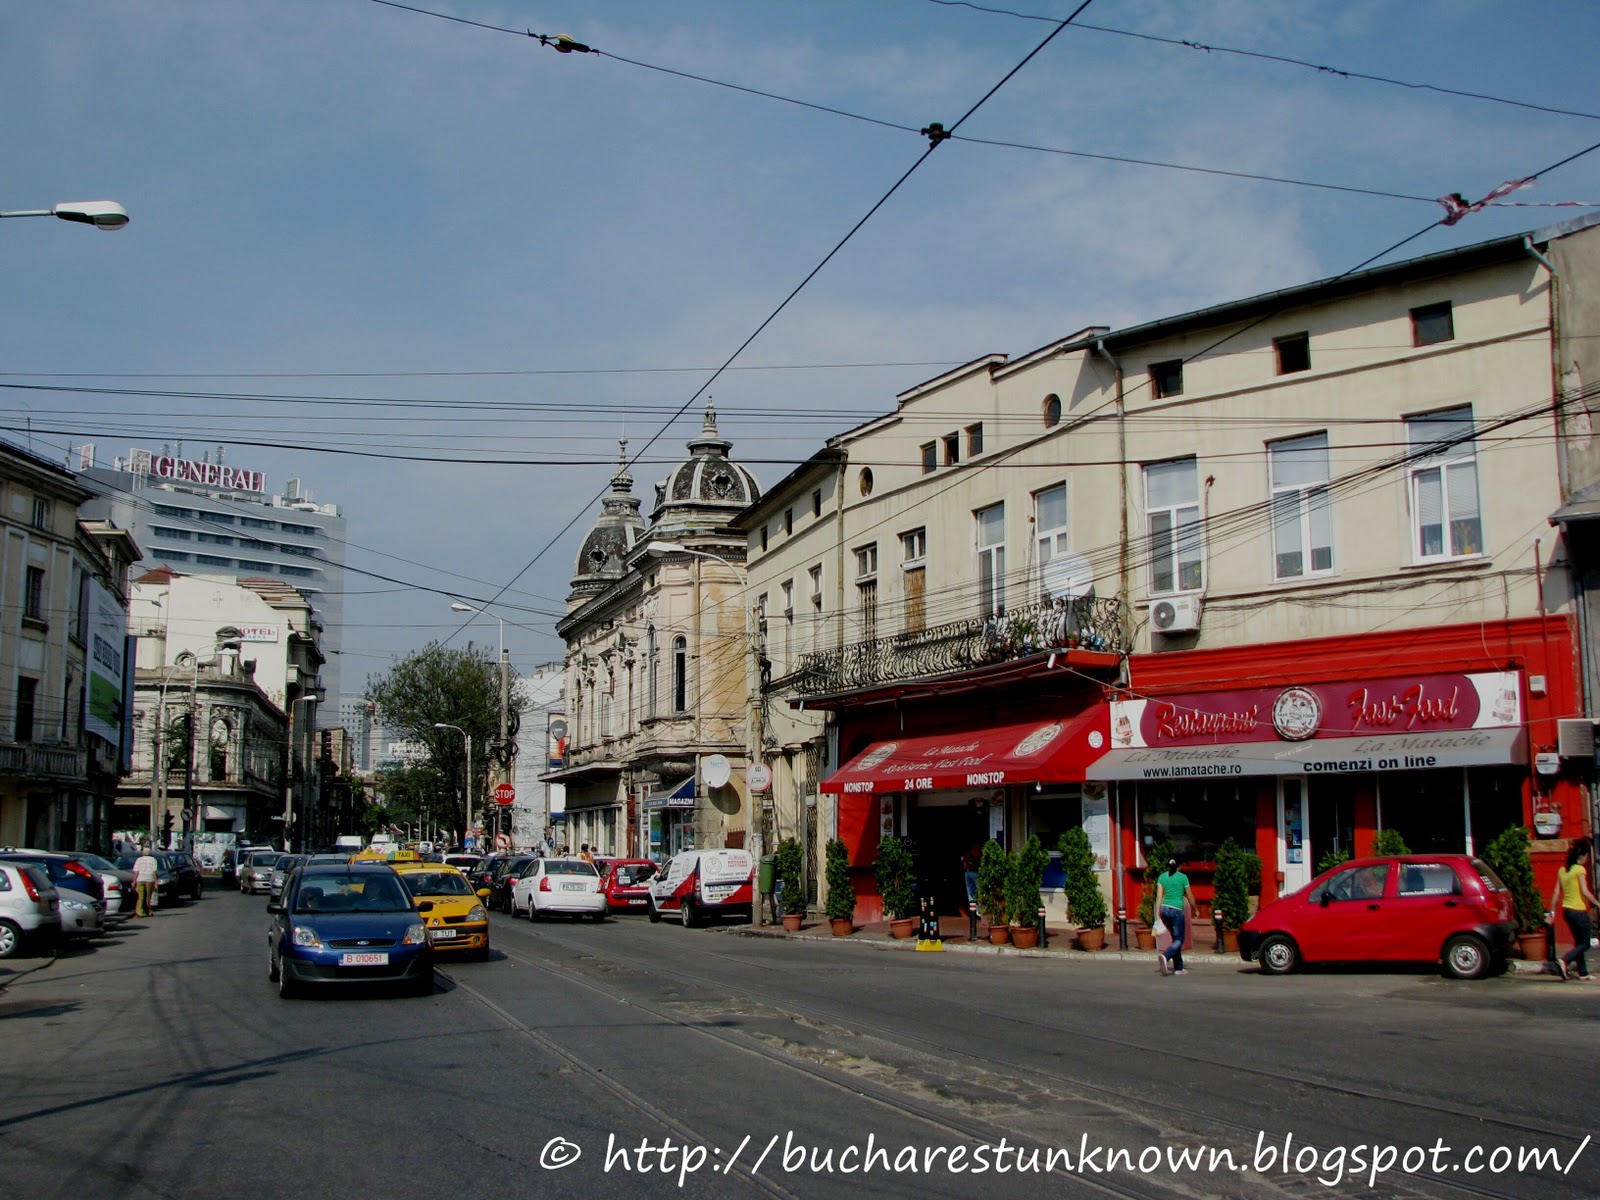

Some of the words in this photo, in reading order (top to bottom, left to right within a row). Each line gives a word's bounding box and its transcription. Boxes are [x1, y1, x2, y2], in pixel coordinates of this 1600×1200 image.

[156, 456, 268, 493] GENERALI
[1155, 702, 1258, 740] Restaurant
[1353, 740, 1385, 753] La
[1389, 732, 1492, 751] Matache
[922, 747, 937, 757] La
[1122, 751, 1149, 763] La
[1152, 745, 1240, 763] Matache
[957, 753, 994, 767] Food
[1303, 756, 1373, 771] comenzi
[1378, 757, 1399, 769] on
[1404, 755, 1437, 768] line
[966, 771, 1005, 785] NONSTOP
[1142, 764, 1242, 778] www.lamatache.ro
[843, 781, 874, 793] NONSTOP
[904, 779, 914, 790] 24
[915, 777, 933, 789] ORE
[495, 789, 515, 799] STOP
[346, 953, 353, 963] B
[356, 953, 382, 963] 010651
